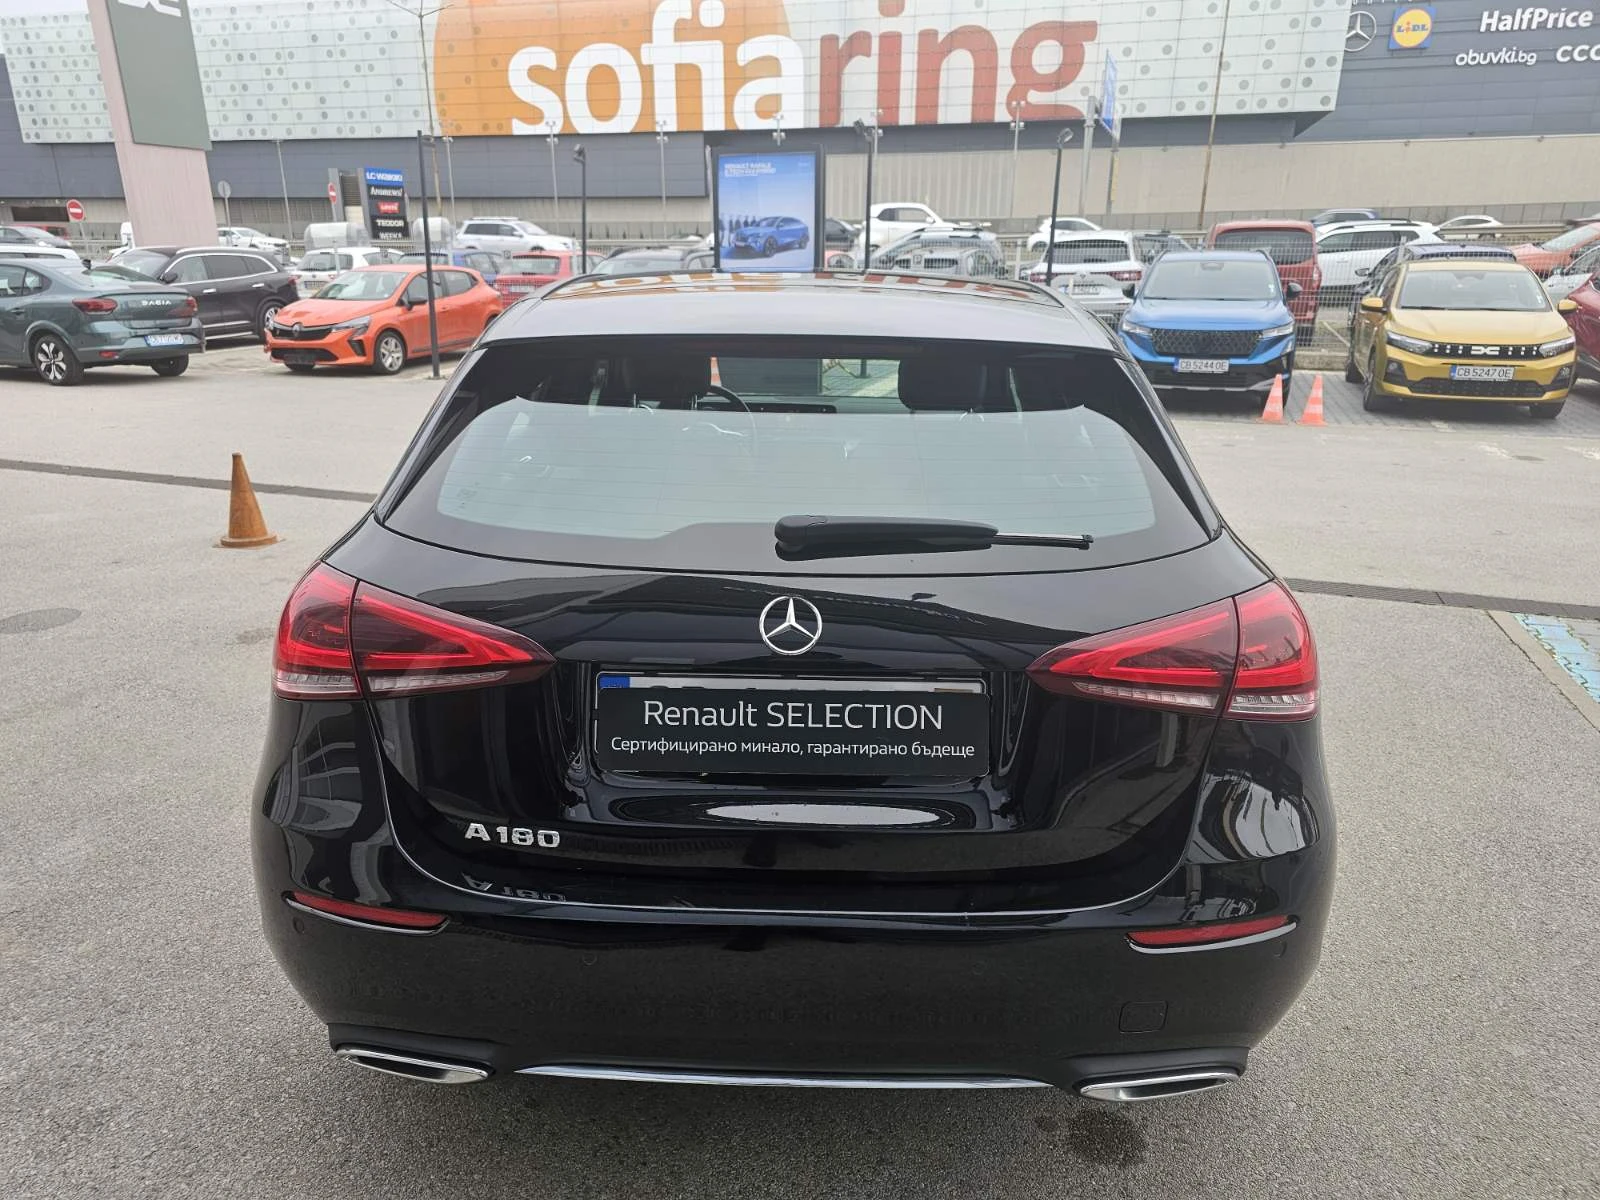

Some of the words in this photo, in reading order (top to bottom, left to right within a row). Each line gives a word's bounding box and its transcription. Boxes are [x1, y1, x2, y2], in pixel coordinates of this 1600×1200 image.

[1479, 8, 1594, 33] HalfPrice
[1455, 46, 1537, 66] obuvki.bg
[376, 218, 404, 227] TEODOR
[644, 700, 758, 727] Renault
[766, 702, 942, 730] SELECTION
[611, 737, 737, 755] Сертифицирано
[741, 741, 804, 756] минало,
[807, 743, 907, 758] гарантирано
[911, 742, 975, 758] бъдеще
